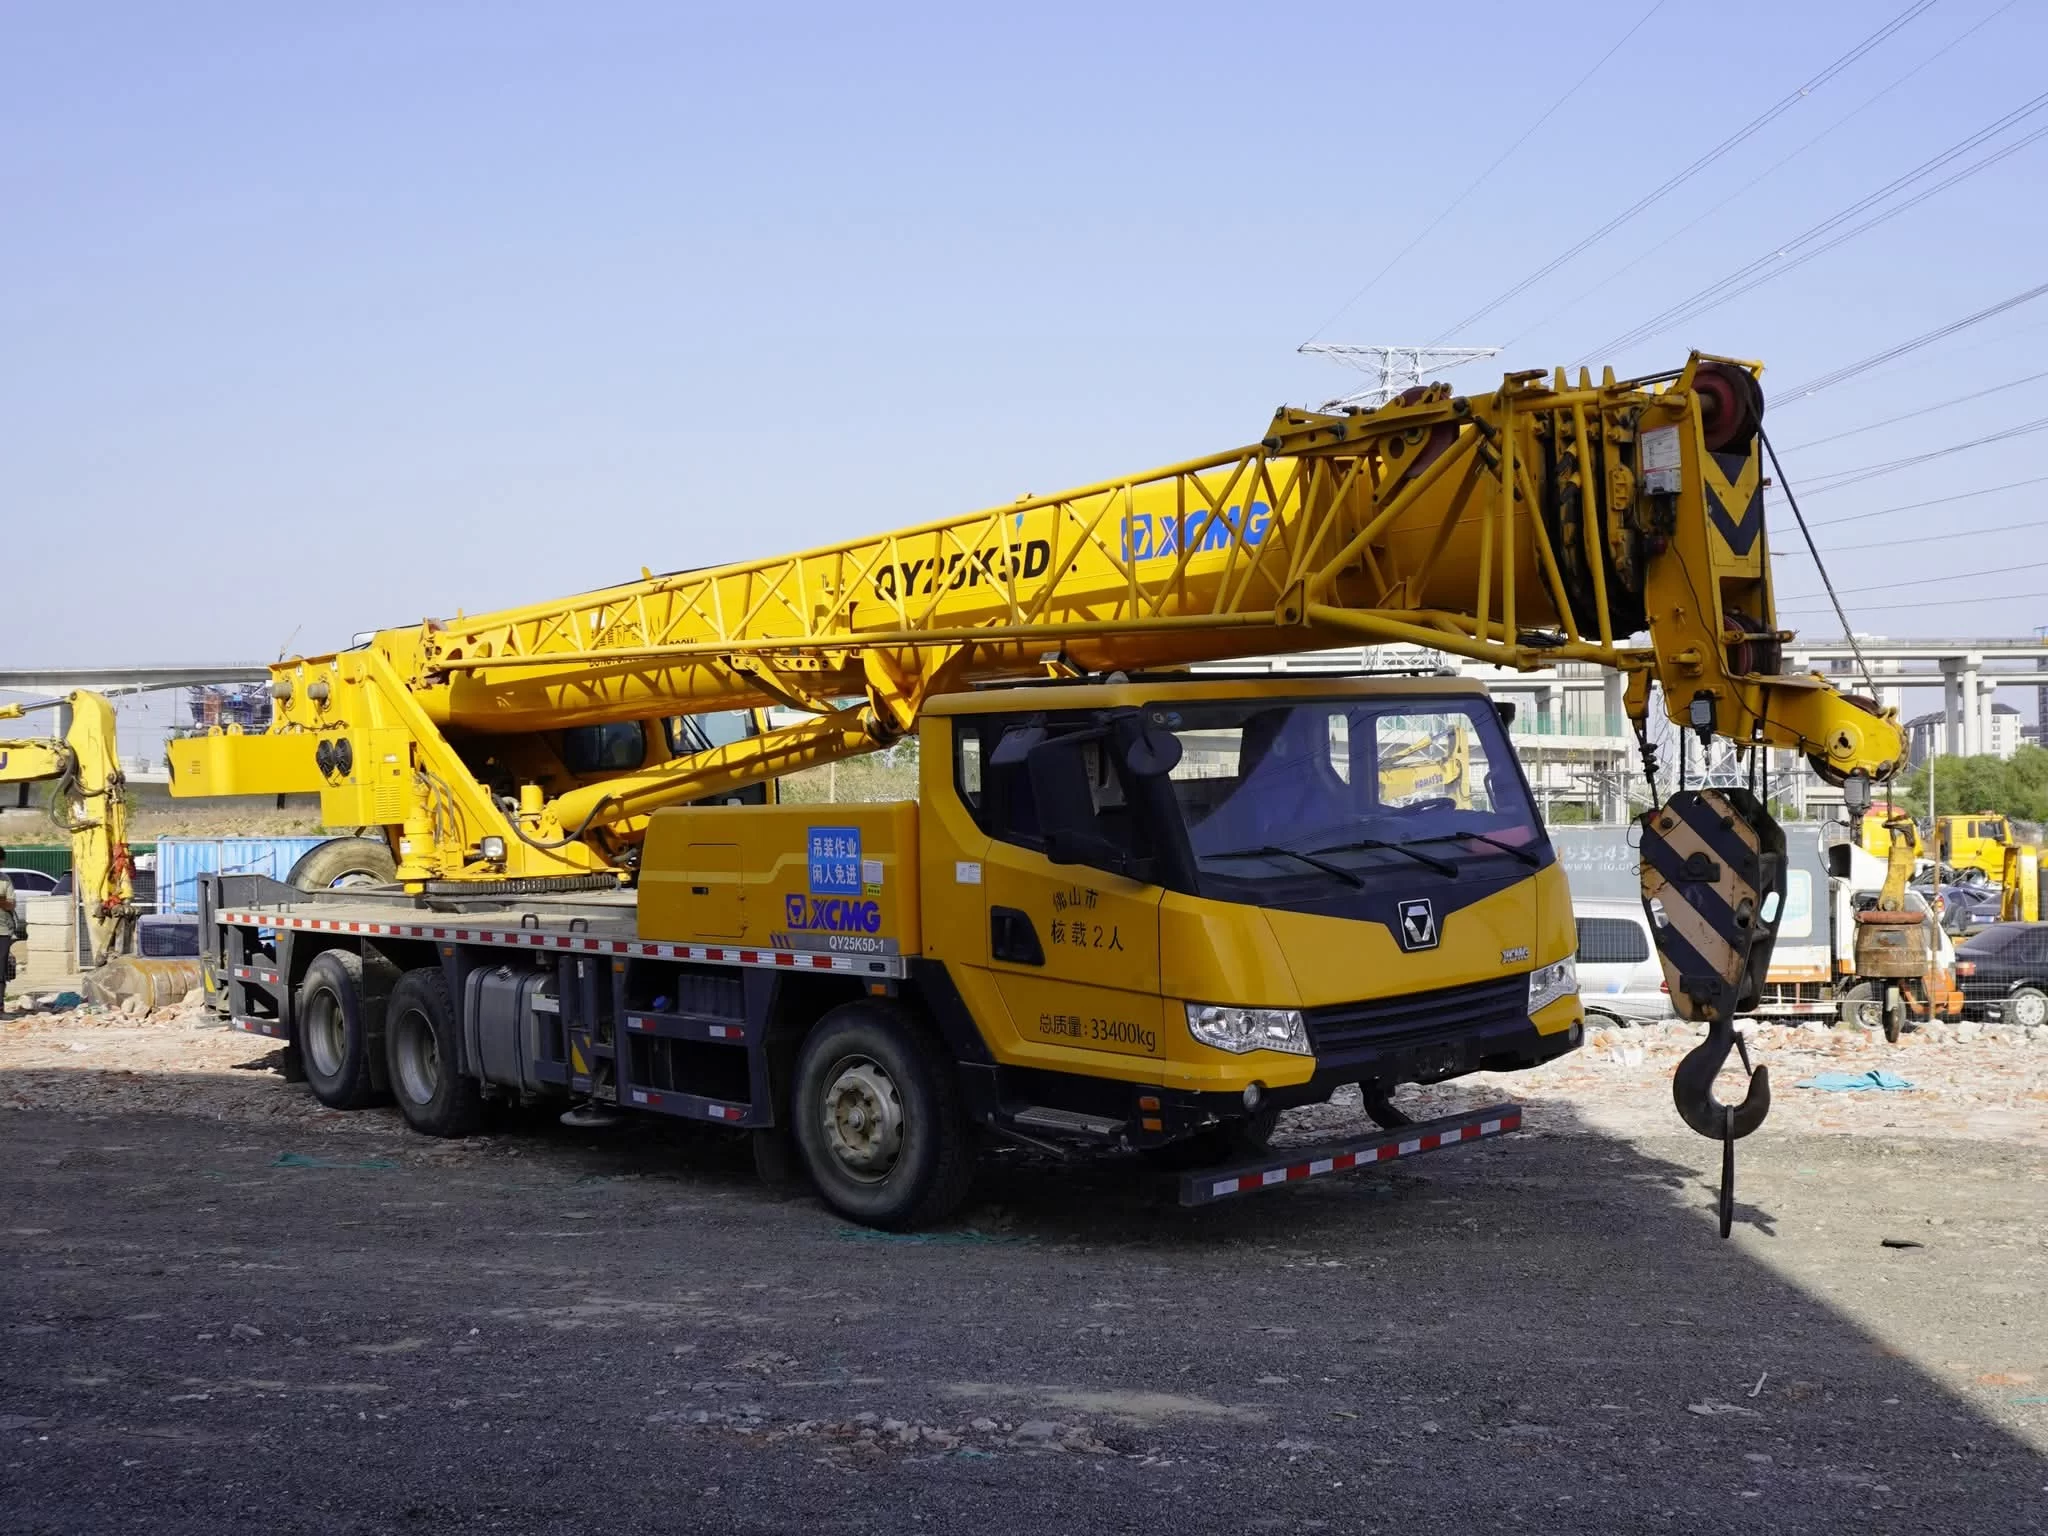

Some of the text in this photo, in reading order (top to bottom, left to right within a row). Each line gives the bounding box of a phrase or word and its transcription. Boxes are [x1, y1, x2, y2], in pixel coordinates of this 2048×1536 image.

[1153, 501, 1272, 558] XCMG
[874, 539, 1050, 601] QY25K5D
[812, 837, 857, 859] 吊装作业
[812, 864, 857, 885] 闲人免进
[808, 899, 881, 933] XCMG
[829, 935, 885, 952] QY25K5D-1
